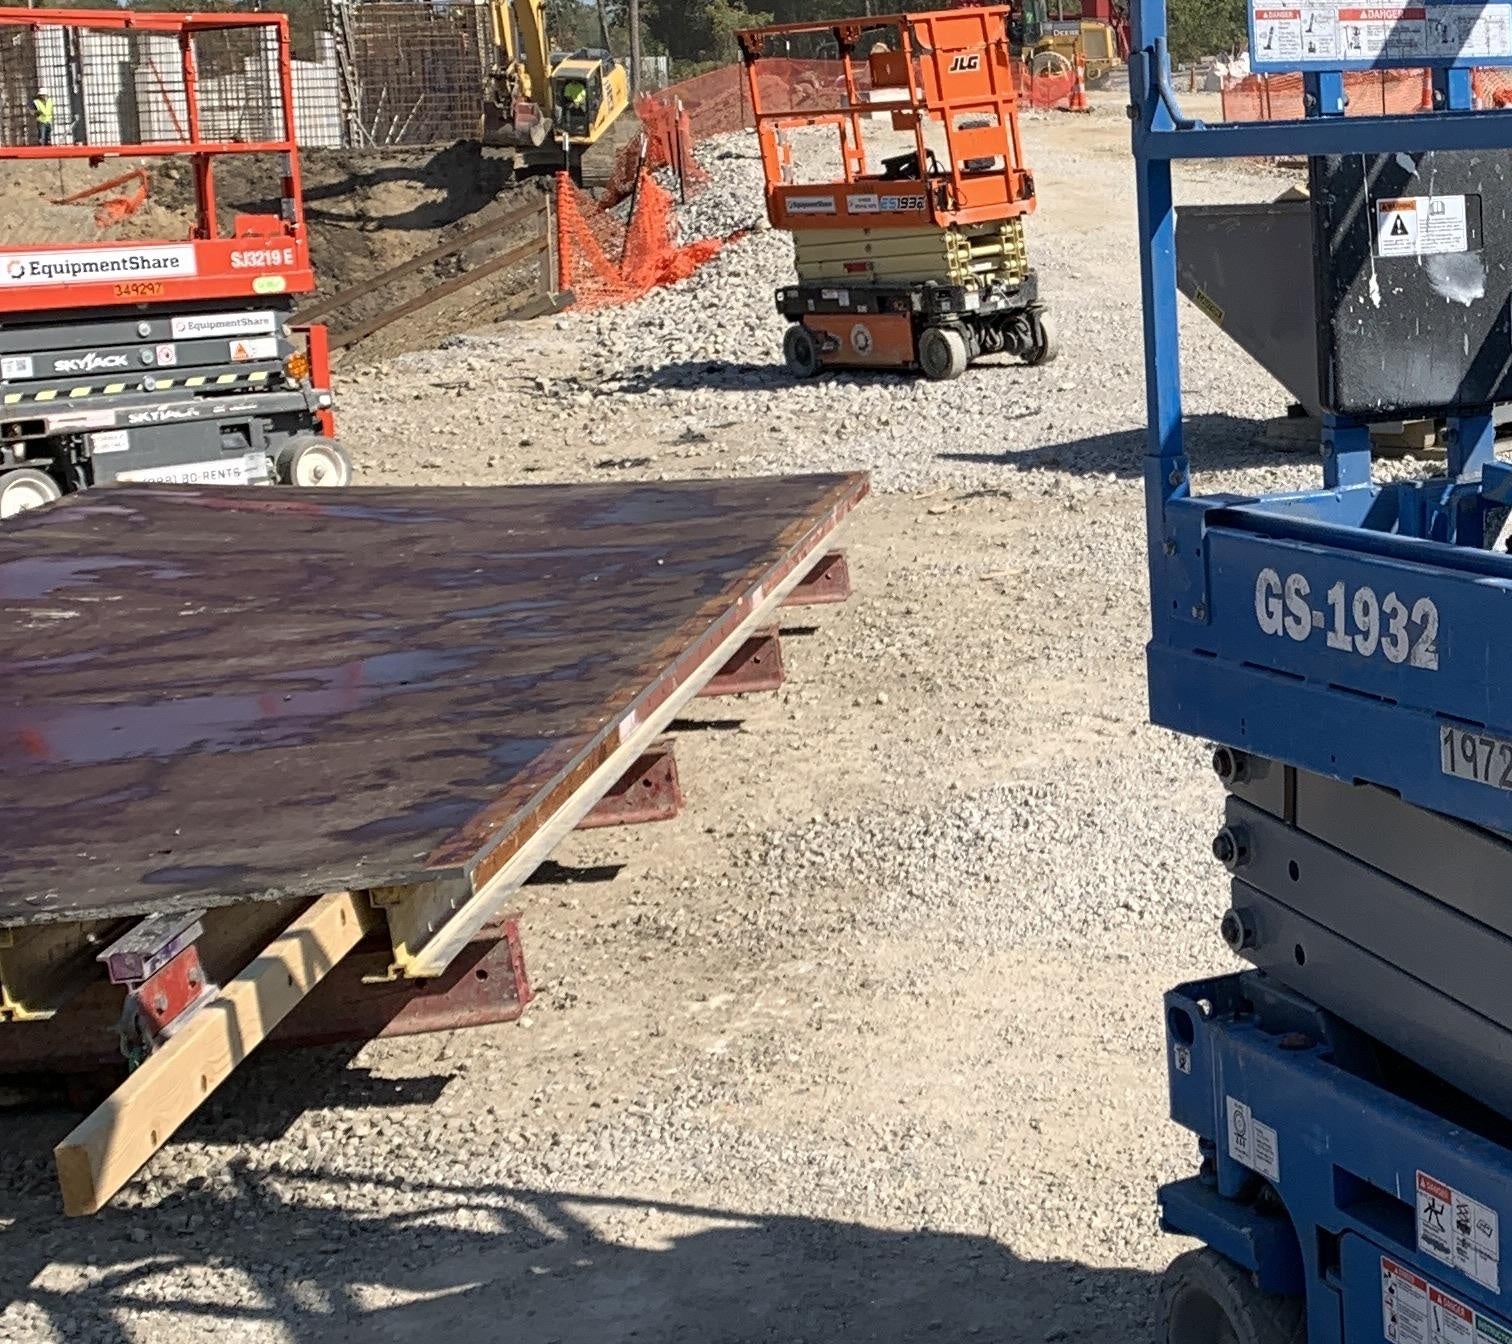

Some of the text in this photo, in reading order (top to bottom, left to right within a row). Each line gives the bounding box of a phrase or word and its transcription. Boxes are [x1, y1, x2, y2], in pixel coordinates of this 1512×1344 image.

[1368, 9, 1404, 19] DANGER
[950, 55, 979, 72] JLG
[29, 255, 180, 278] EquipmentShare
[231, 248, 294, 269] SJ3219 E
[115, 282, 162, 297] 349297
[187, 316, 270, 331] EquipmentShare
[54, 351, 128, 373] SKYJACK
[1255, 567, 1439, 671] GS-1932
